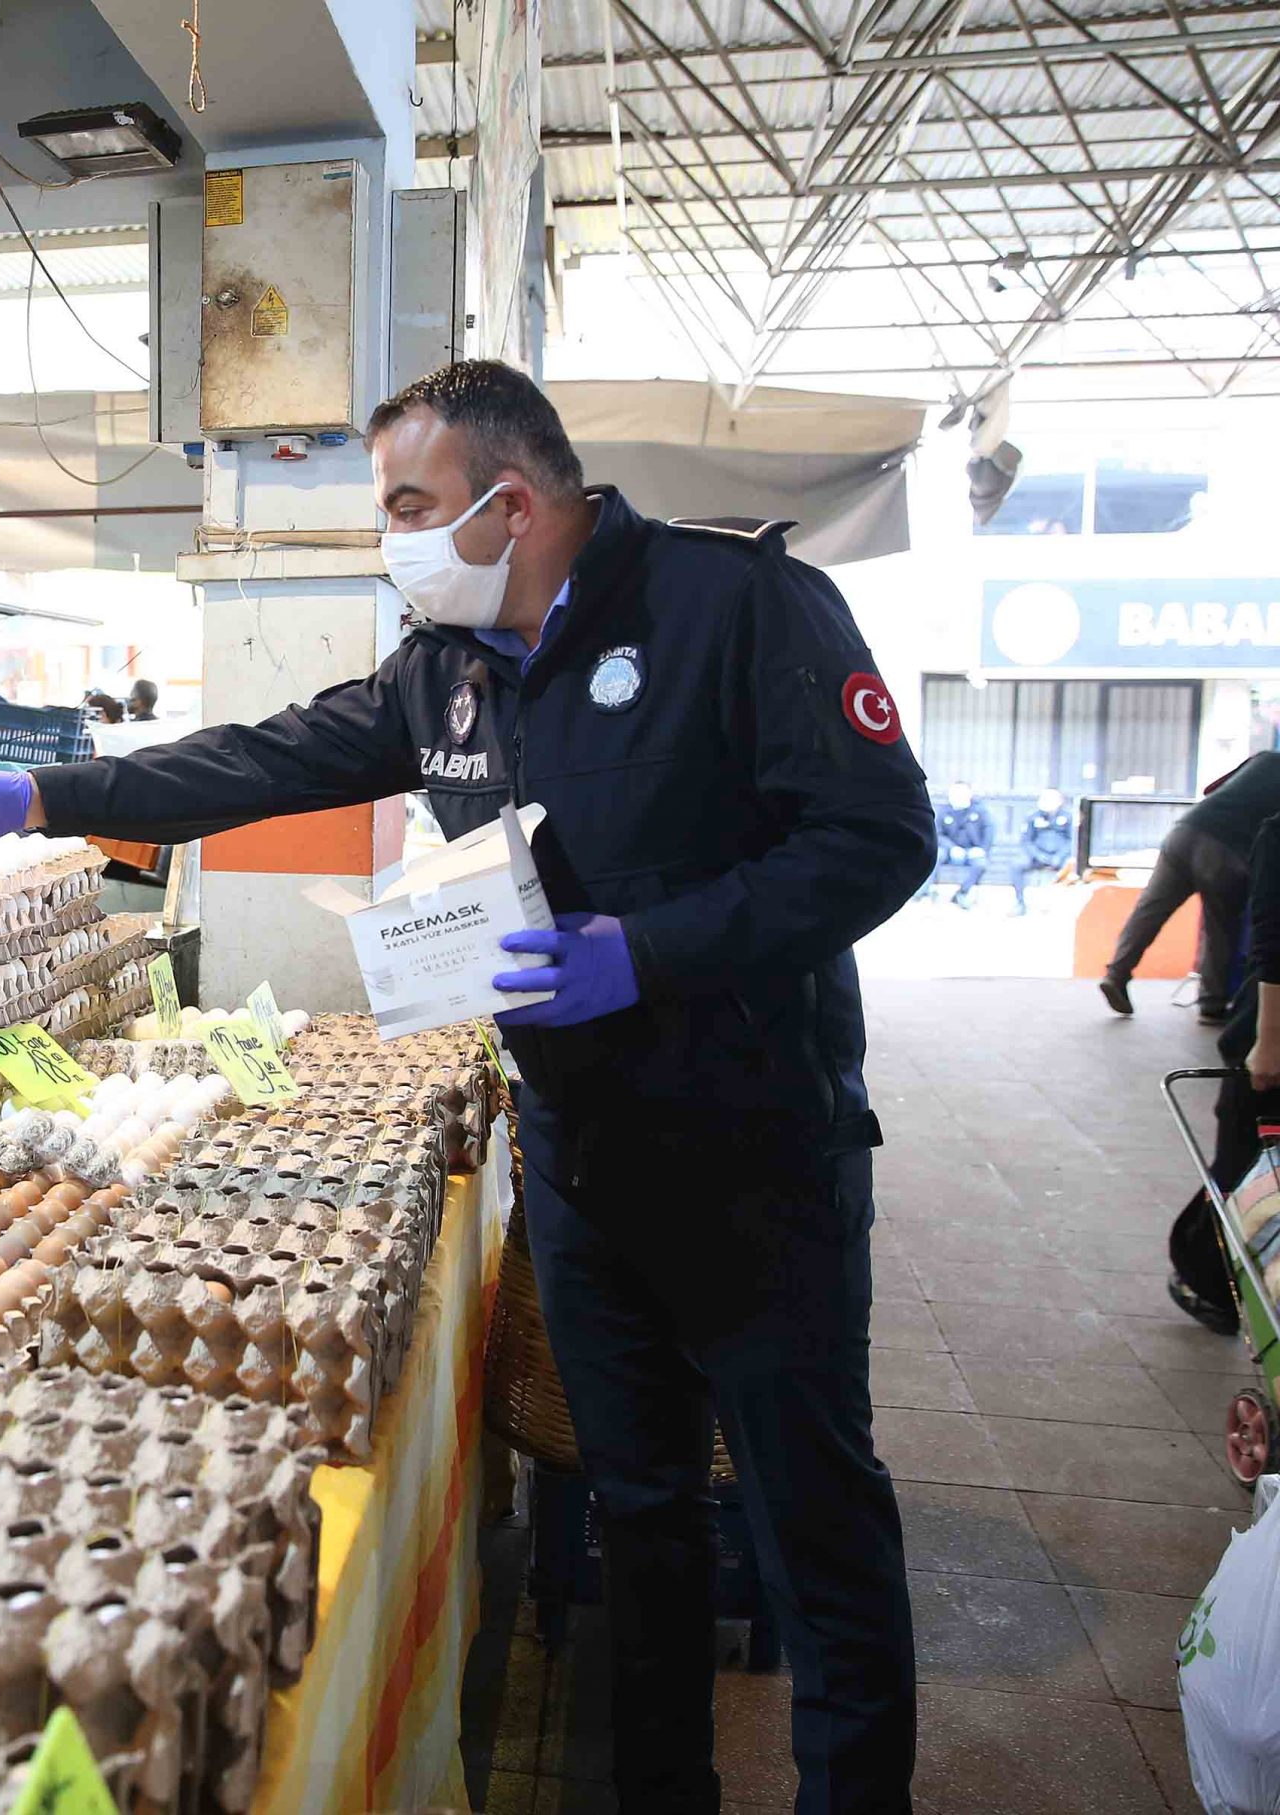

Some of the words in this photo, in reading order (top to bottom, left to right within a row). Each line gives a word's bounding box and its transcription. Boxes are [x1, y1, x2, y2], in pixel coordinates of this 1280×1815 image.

[598, 646, 638, 663] ZABITA
[419, 747, 488, 780] ZABITA
[380, 902, 485, 940] FACEMASK
